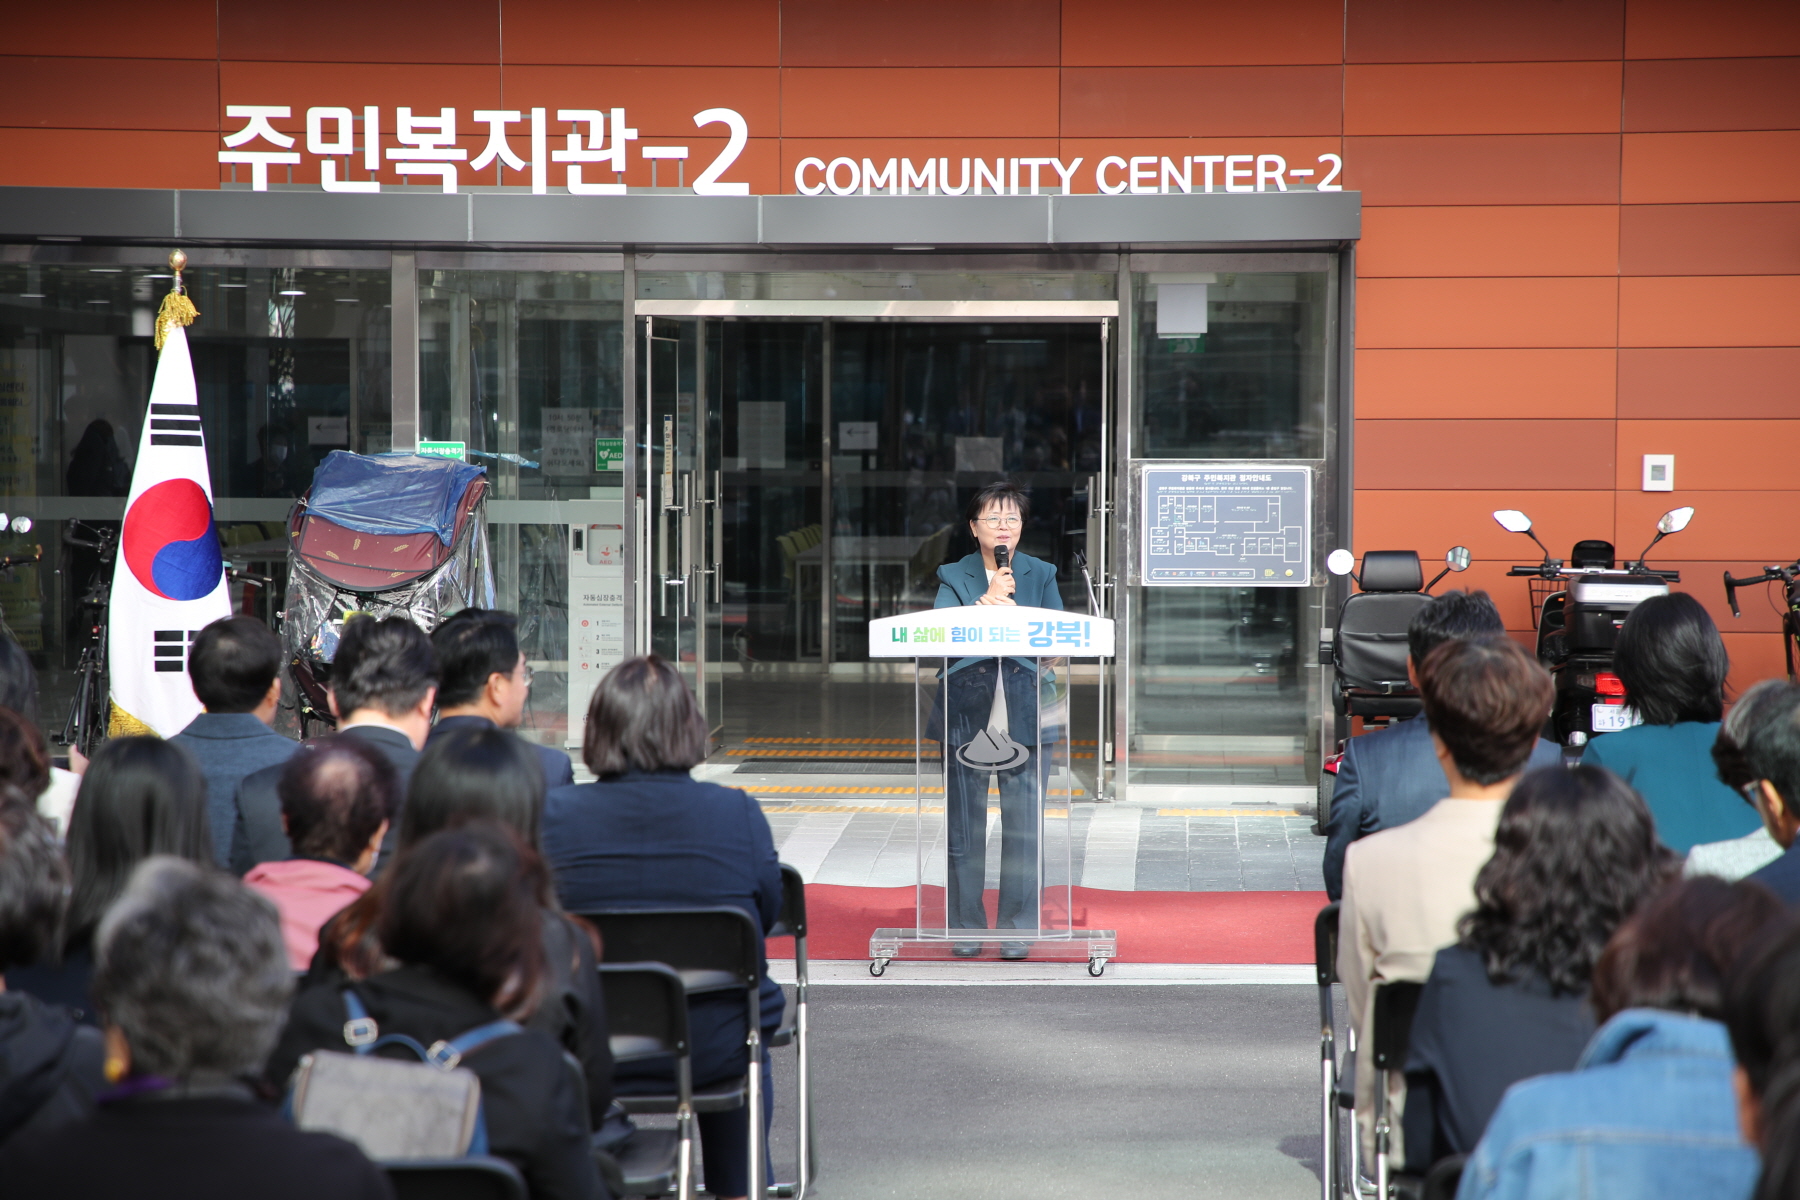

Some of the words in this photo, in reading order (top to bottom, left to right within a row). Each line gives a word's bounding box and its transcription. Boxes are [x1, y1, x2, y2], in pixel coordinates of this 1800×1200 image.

[218, 105, 750, 196] 주민복지관-2
[794, 156, 1084, 197] COMMUNITY
[1096, 153, 1344, 195] CENTER-2
[892, 626, 908, 643] 내
[913, 626, 946, 643] 삶에
[951, 626, 983, 643] 힘이
[988, 626, 1021, 643] 되는
[1027, 621, 1091, 648] 강북!
